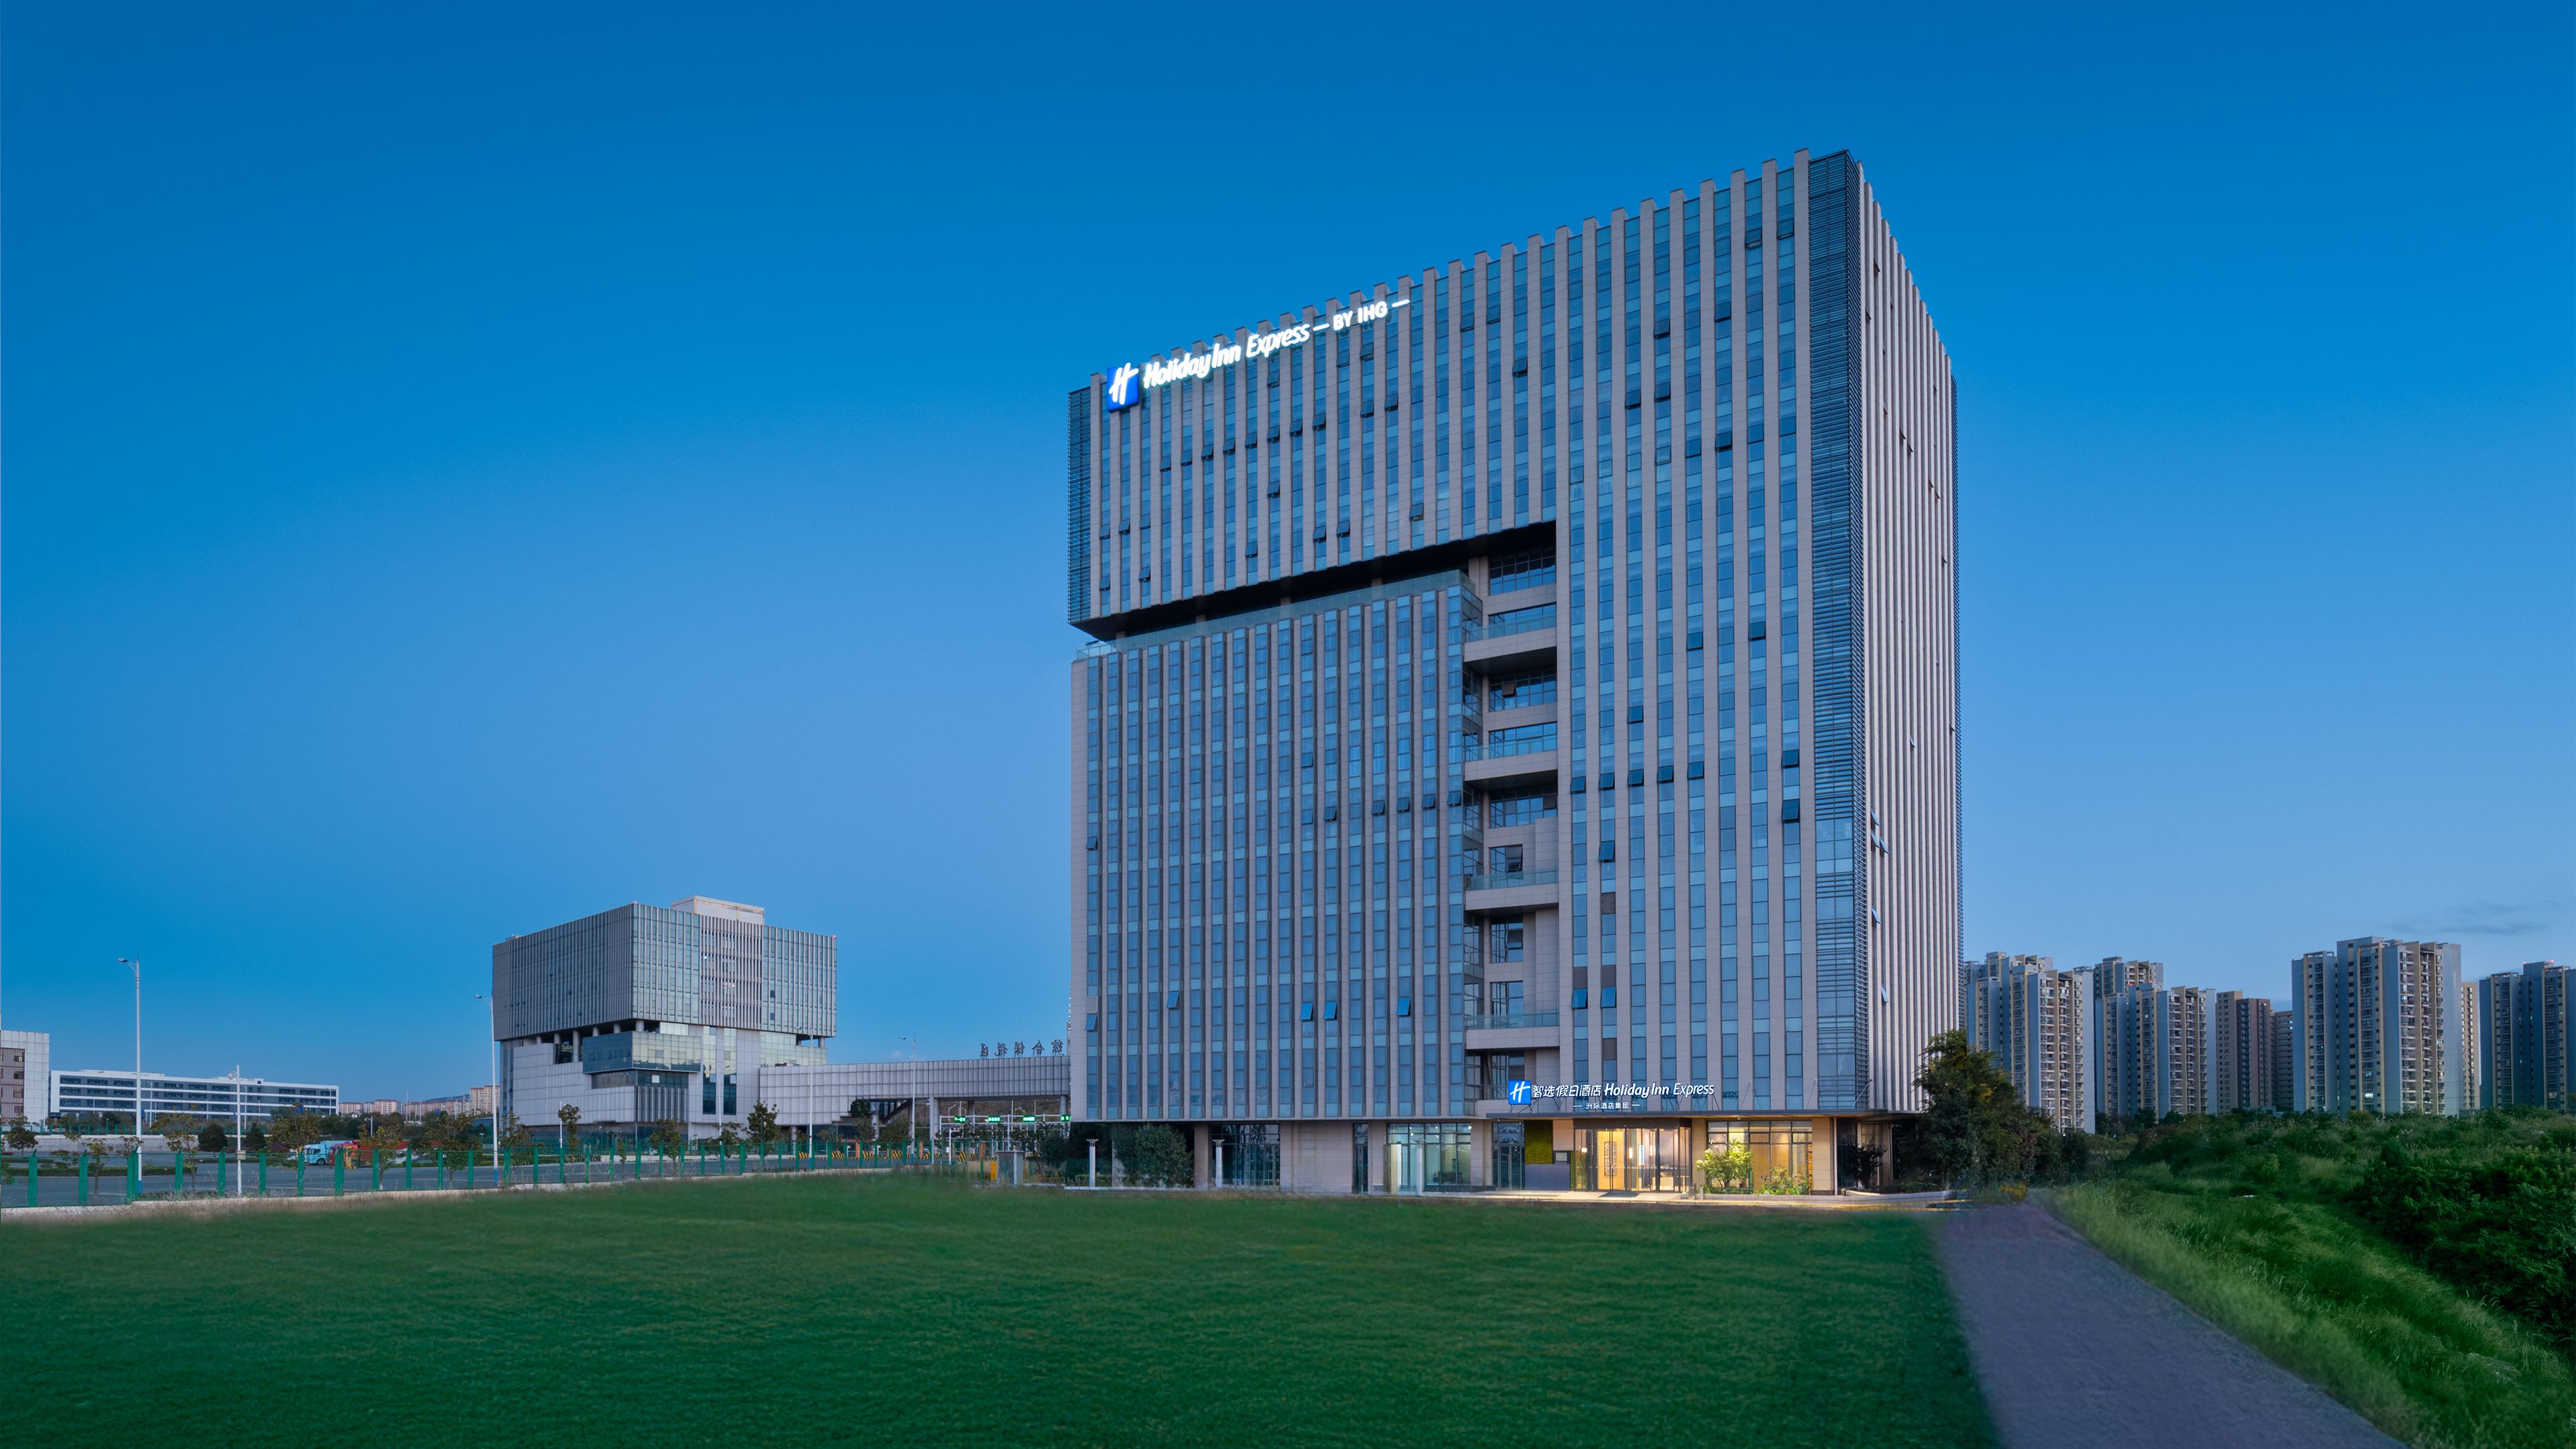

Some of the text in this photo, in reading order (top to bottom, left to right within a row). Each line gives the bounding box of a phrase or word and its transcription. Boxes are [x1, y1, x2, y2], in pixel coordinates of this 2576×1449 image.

[1143, 352, 1212, 389] Holiday
[1212, 343, 1242, 368] Inn
[1246, 323, 1311, 358] Express
[1333, 310, 1353, 331] BY
[1358, 301, 1388, 324] IHG
[1533, 1084, 1602, 1098] 智选假日酒店
[1604, 1083, 1650, 1098] Holiday
[1651, 1082, 1670, 1095] Inn
[1673, 1083, 1715, 1098] Express
[1585, 1102, 1629, 1110] 洲际酒店集团
